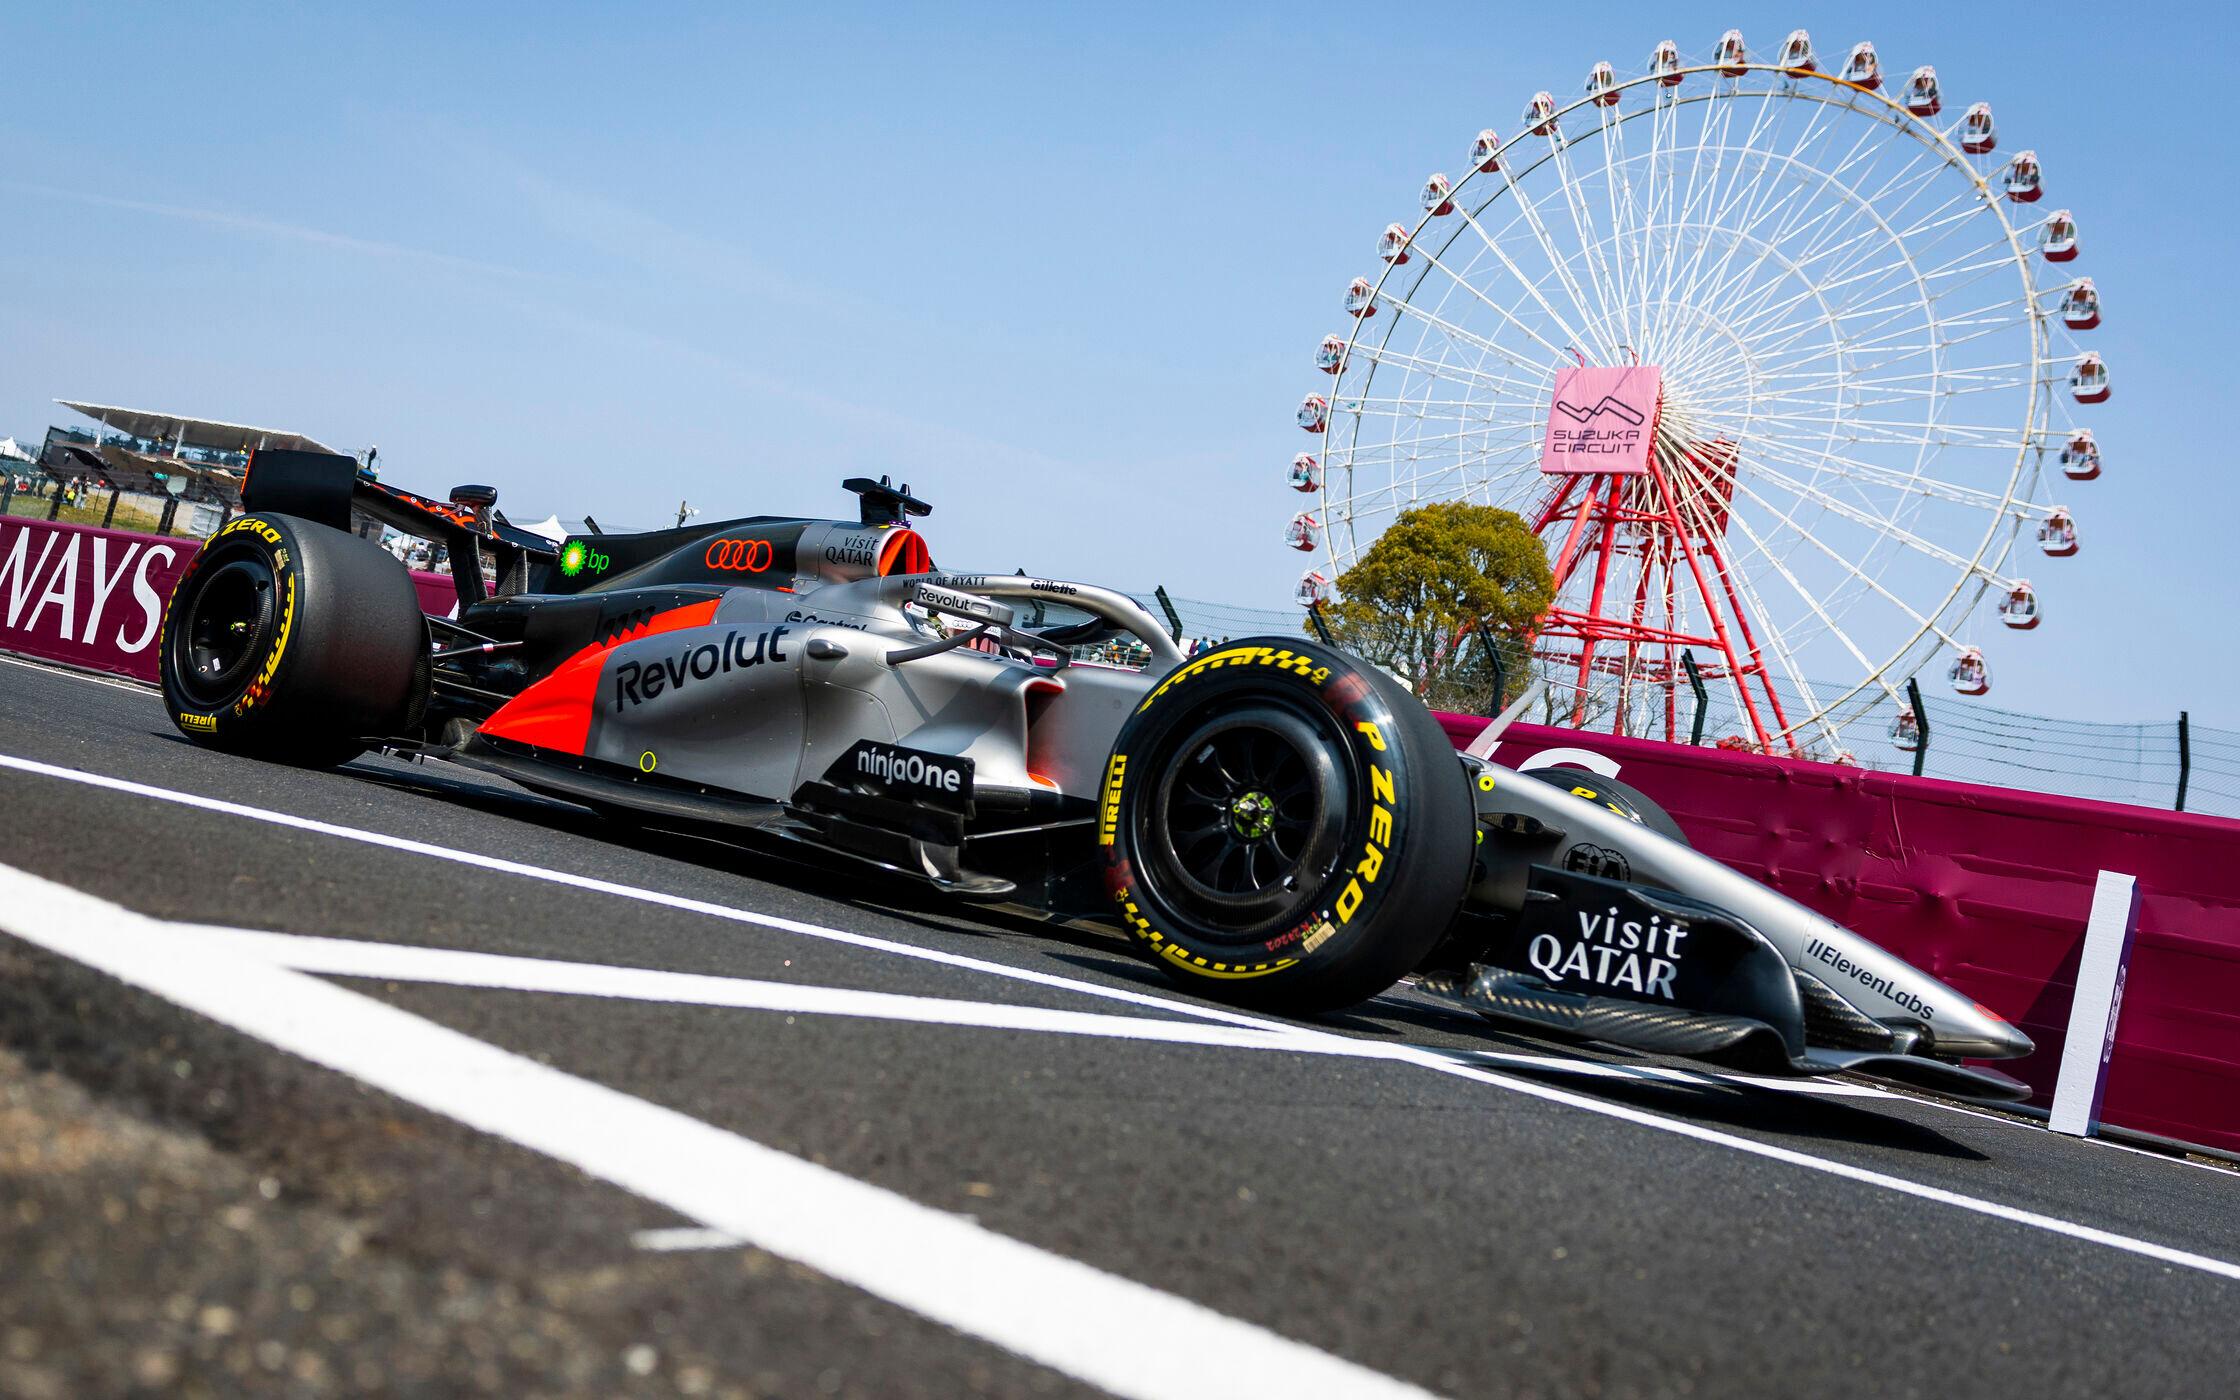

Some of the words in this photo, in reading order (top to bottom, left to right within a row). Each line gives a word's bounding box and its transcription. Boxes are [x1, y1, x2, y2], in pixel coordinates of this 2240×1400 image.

[1553, 430, 1640, 440] SUZUKA
[1553, 443, 1635, 453] CIRCUIT
[220, 518, 282, 543] ZERO
[844, 535, 879, 551] visit
[588, 549, 610, 574] bp
[825, 546, 873, 567] QATAR
[936, 577, 948, 586] OF
[952, 576, 986, 586] HYATT
[1031, 579, 1077, 595] Gillette
[917, 587, 970, 611] Revolut
[616, 625, 793, 713] Revolut
[1356, 721, 1387, 751] P
[857, 746, 961, 792] ninjaOne
[1099, 754, 1128, 845] PIRELLI
[1335, 764, 1396, 924] ZERO
[1579, 906, 1688, 959] visit
[1529, 933, 1678, 1000] QATAR
